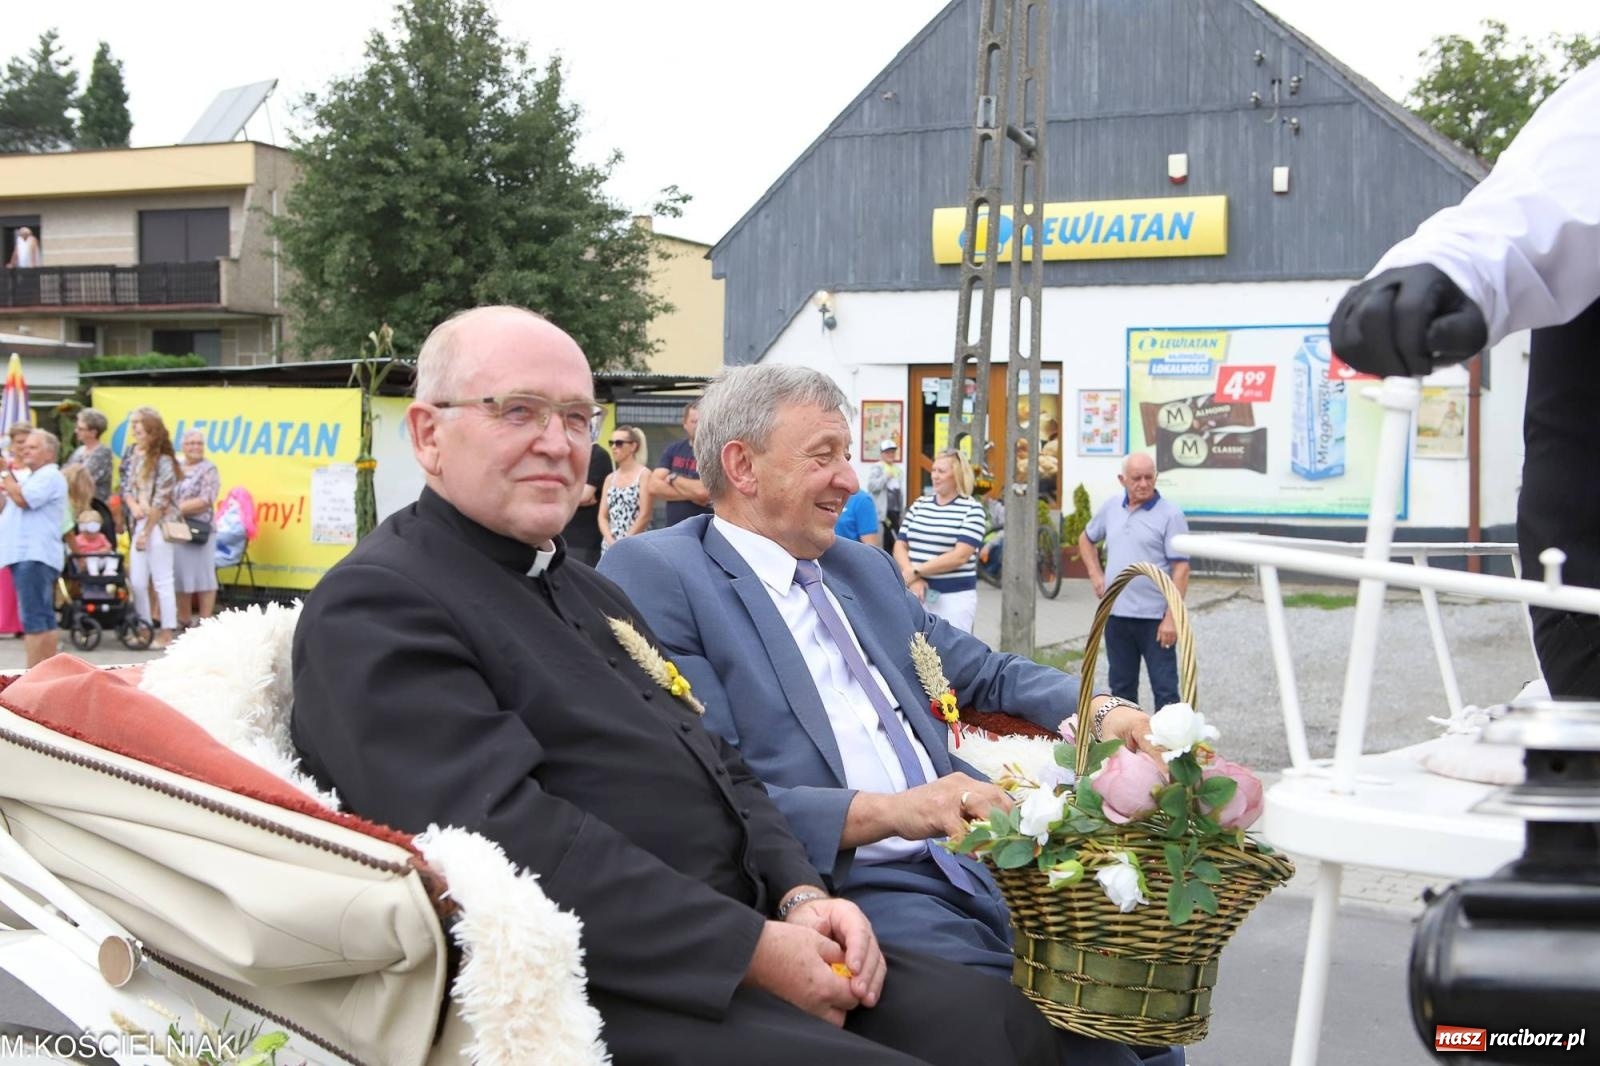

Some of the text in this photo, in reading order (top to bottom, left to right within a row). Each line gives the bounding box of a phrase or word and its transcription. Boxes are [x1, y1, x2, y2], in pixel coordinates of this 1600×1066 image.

[1159, 337, 1218, 349] LEWIATAN
[1151, 362, 1209, 374] LOKALNOŚCI
[1166, 407, 1184, 424] M
[1196, 405, 1230, 416] ALMOND
[1181, 439, 1198, 454] M
[1212, 445, 1245, 454] CLASSIC
